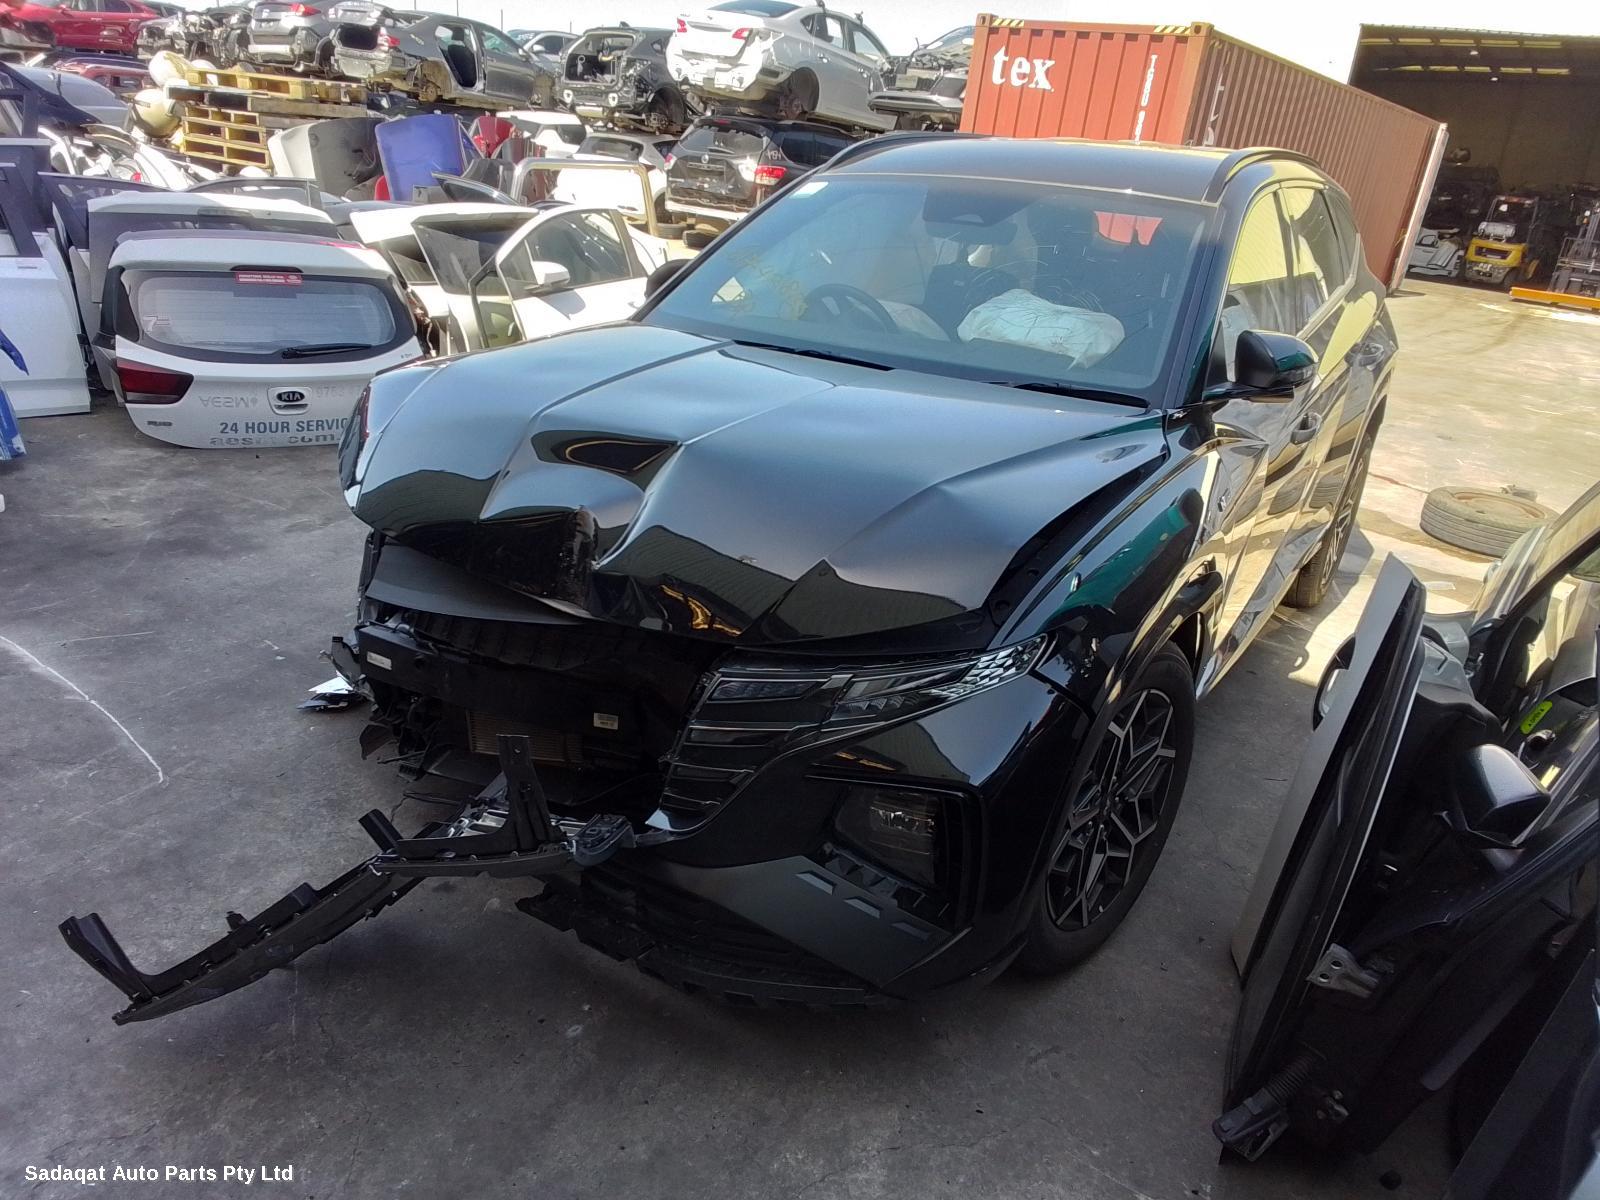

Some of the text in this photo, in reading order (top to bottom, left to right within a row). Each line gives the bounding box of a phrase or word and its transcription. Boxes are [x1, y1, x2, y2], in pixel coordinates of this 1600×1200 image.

[991, 46, 1055, 91] tex
[279, 391, 304, 402] KIA
[219, 417, 348, 434] 24 HOUR SERVIC
